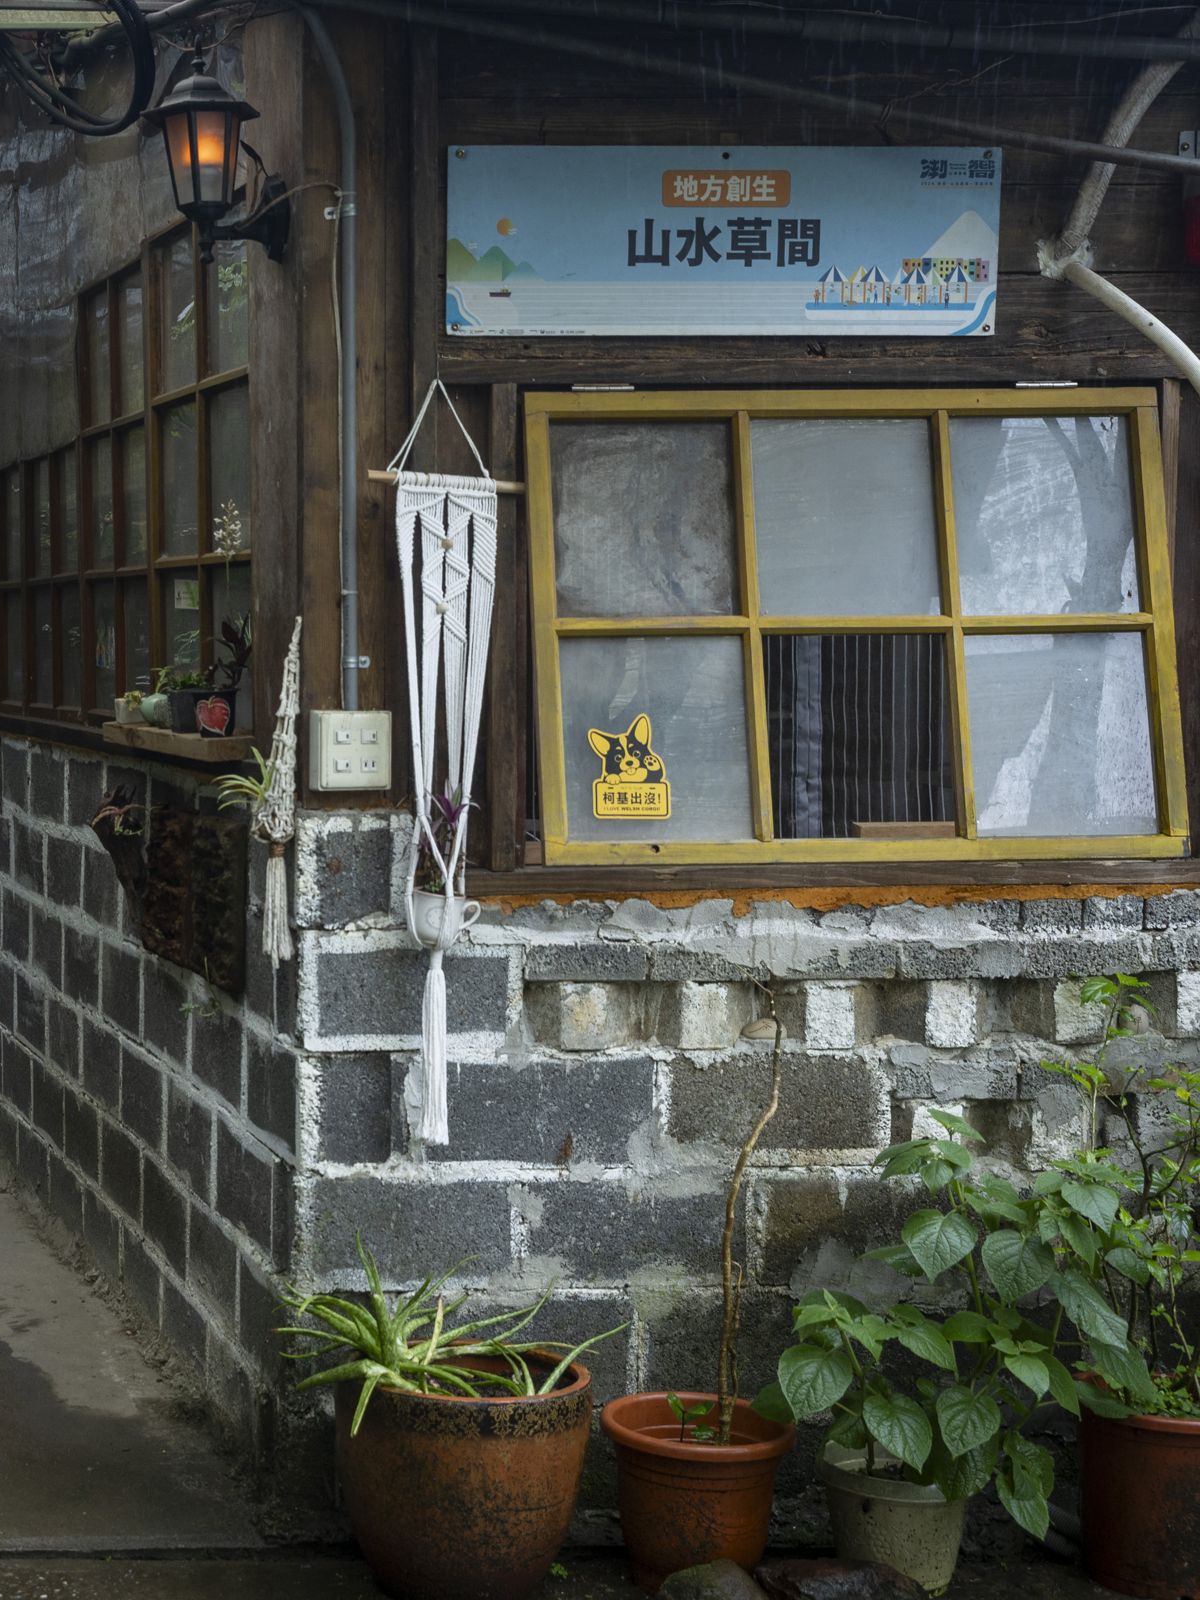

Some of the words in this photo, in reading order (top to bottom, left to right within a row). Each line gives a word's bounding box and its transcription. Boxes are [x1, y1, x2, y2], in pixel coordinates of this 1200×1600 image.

[673, 175, 777, 202] 地方創生
[627, 216, 821, 268] 山水草間
